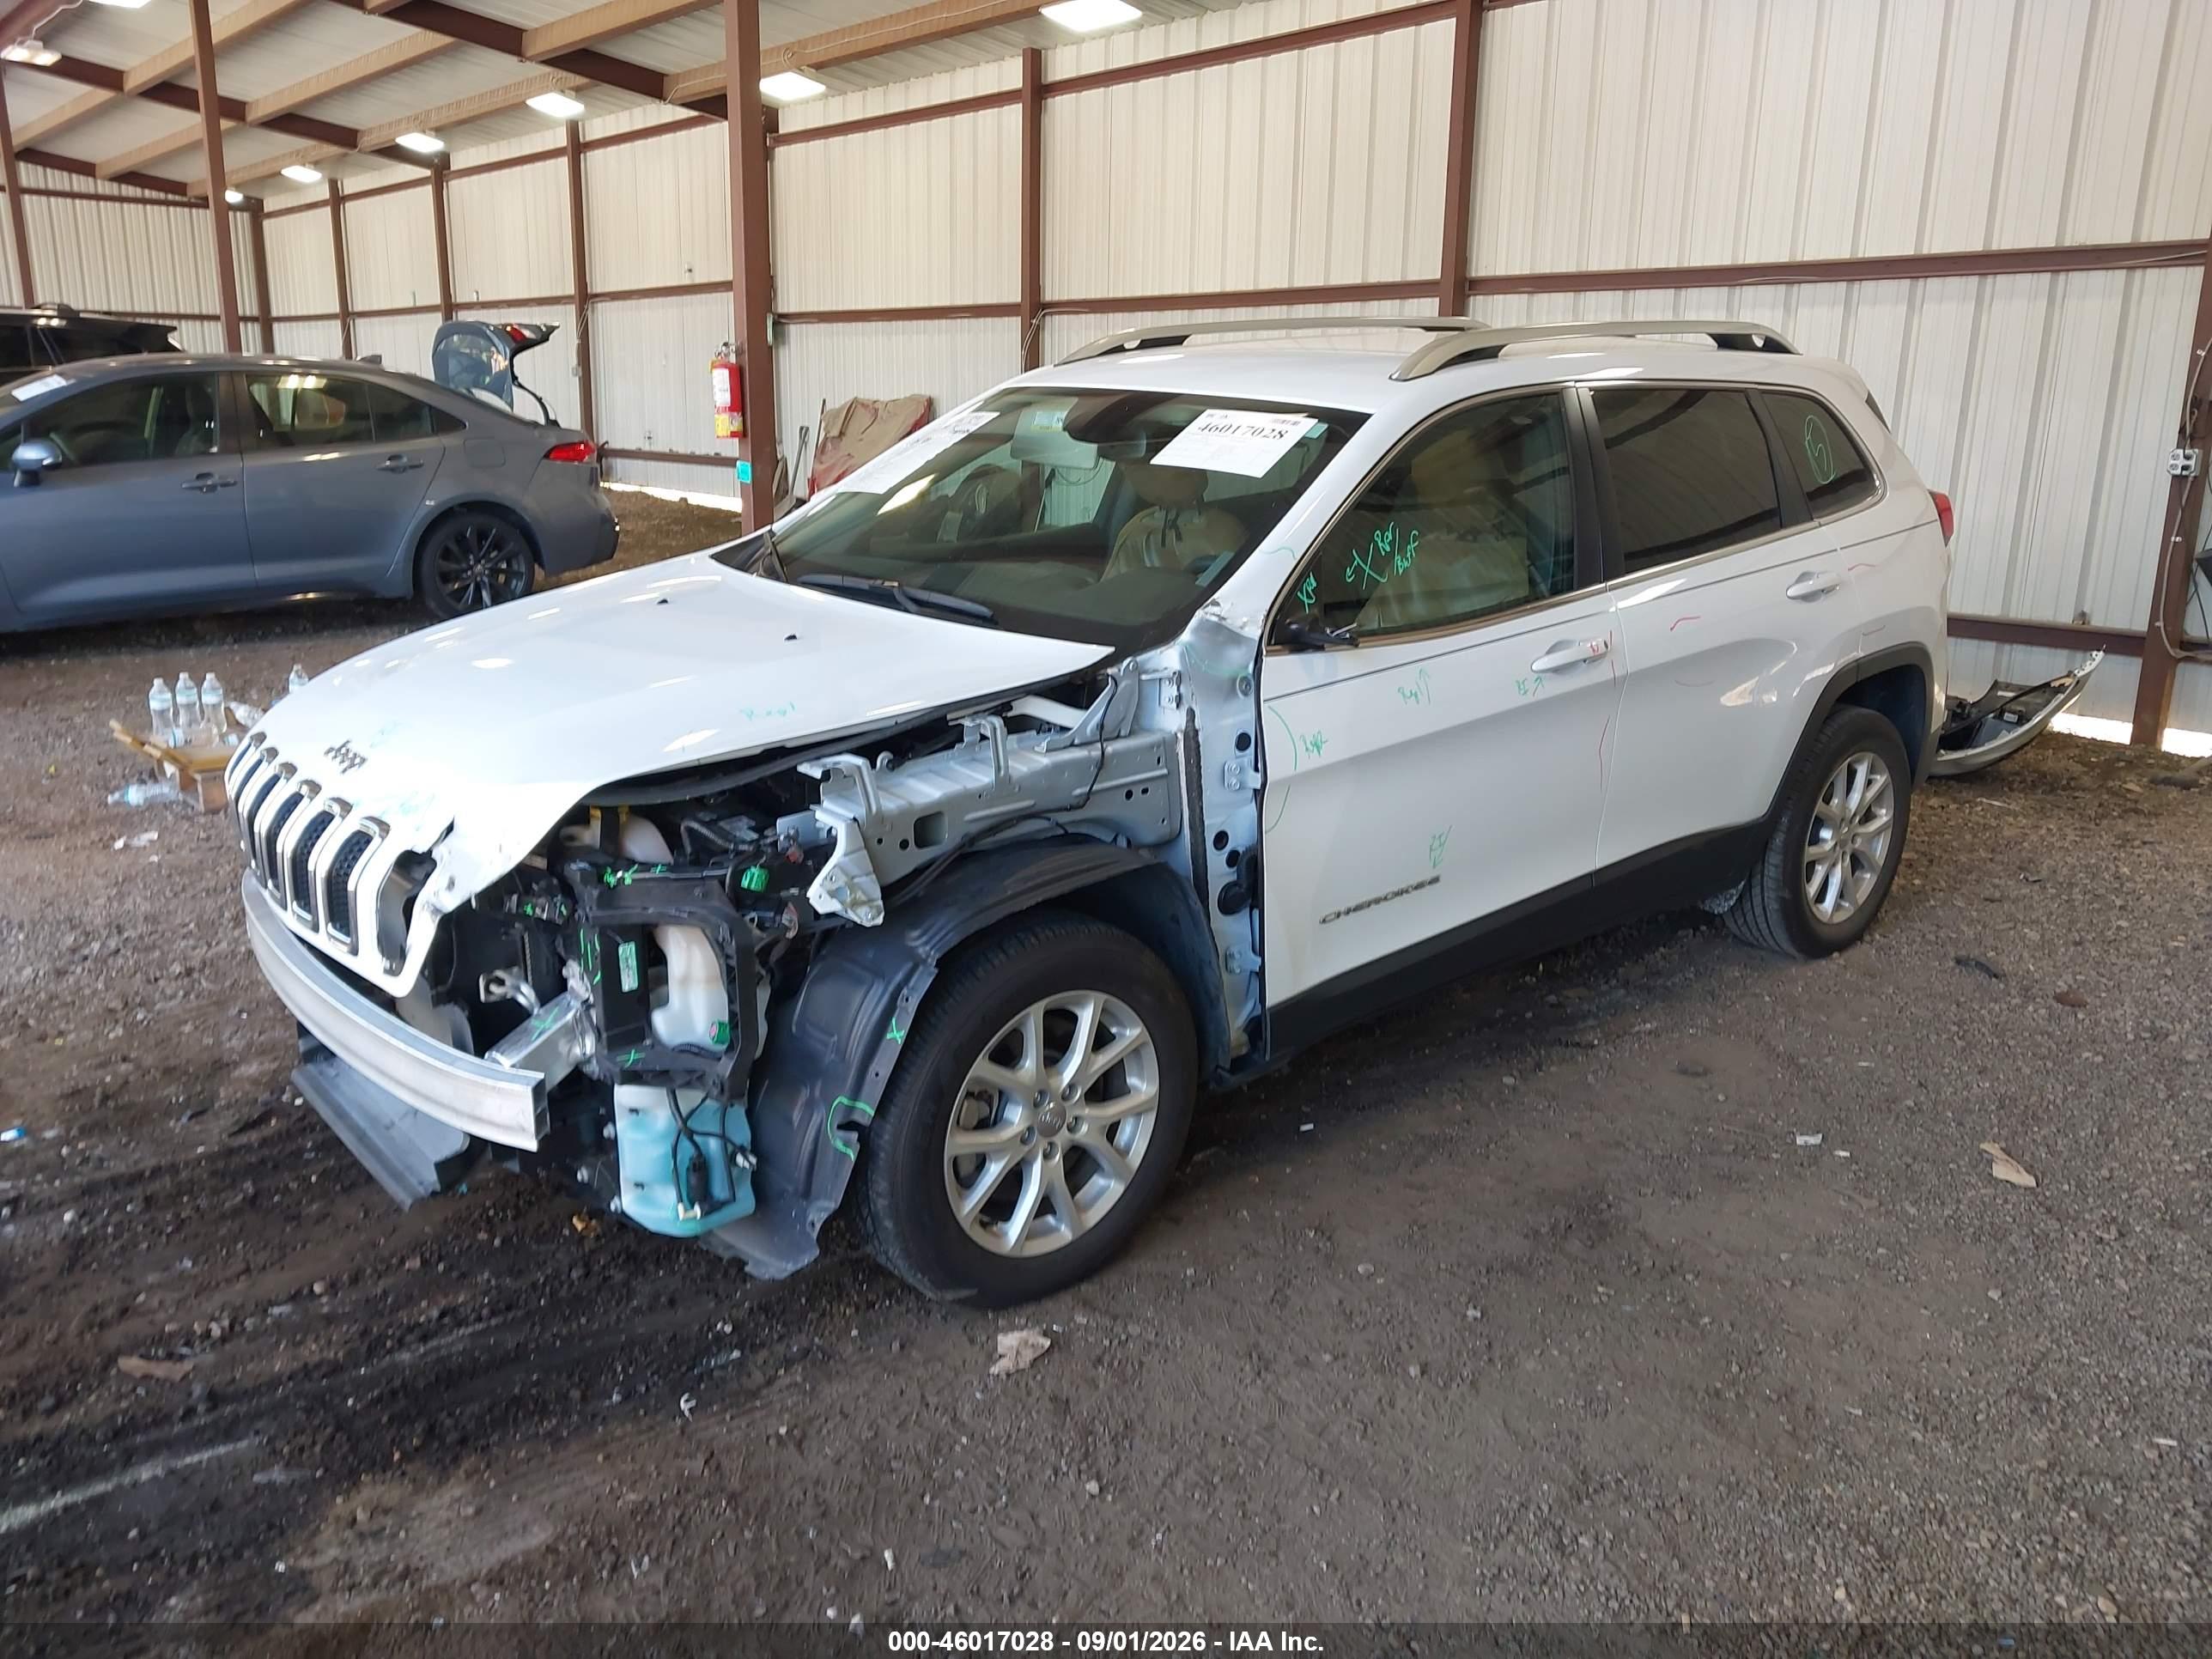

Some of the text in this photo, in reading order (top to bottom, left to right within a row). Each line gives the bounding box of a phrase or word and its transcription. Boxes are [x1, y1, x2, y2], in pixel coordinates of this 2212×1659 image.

[1197, 422, 1289, 441] 46017028
[323, 738, 368, 775] Jeep
[1318, 874, 1441, 926] CHEROKEE
